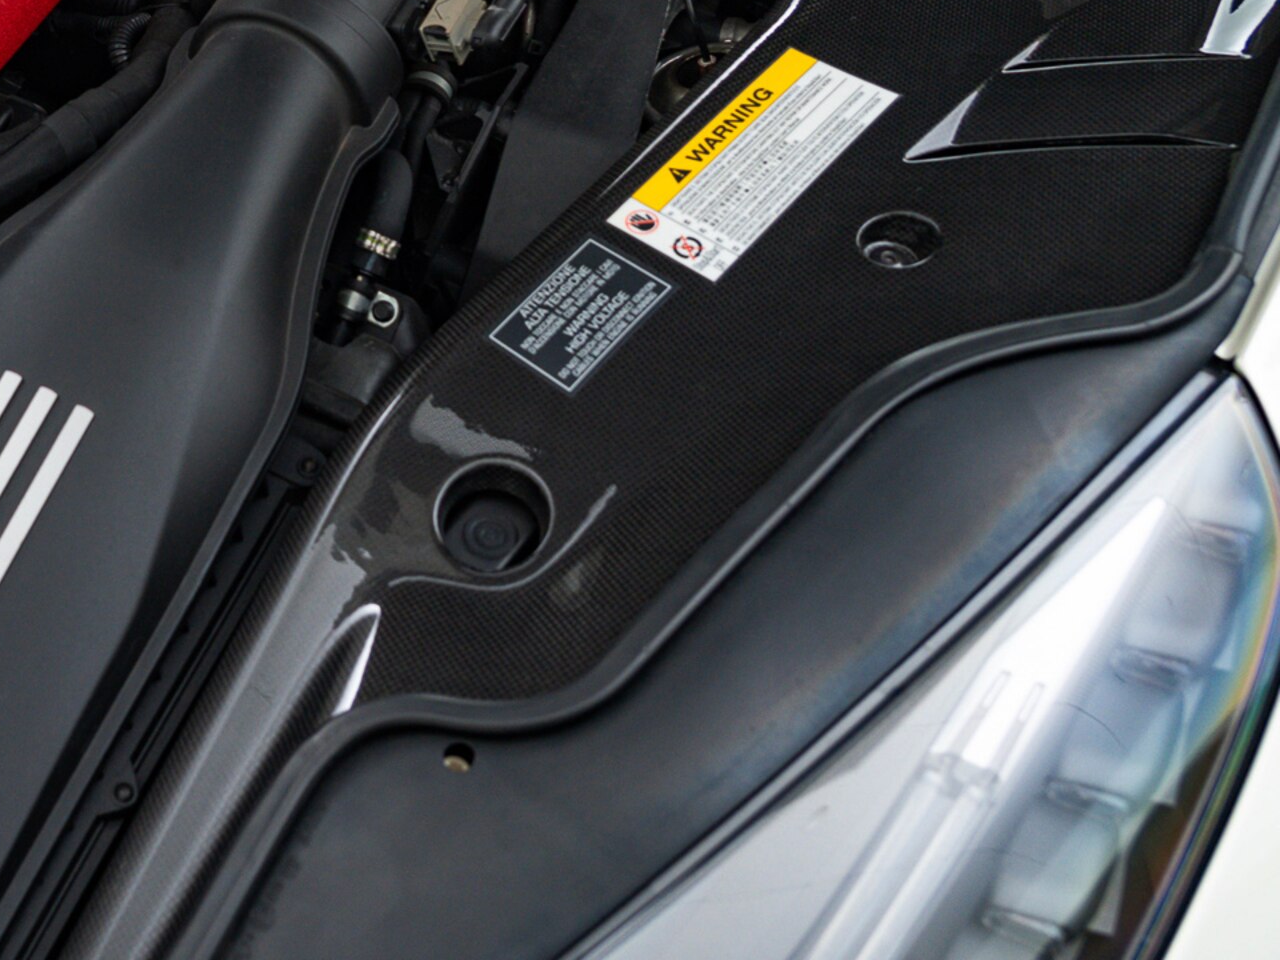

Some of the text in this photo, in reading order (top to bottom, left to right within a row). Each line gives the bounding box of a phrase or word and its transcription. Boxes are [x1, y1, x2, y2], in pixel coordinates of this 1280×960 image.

[685, 87, 773, 163] WARNING
[520, 263, 576, 318] ATTENZIONE
[524, 264, 591, 330] ALTA TENSIONE
[562, 292, 609, 336] WARNING
[564, 289, 630, 354] HIGH VOLTAGE
